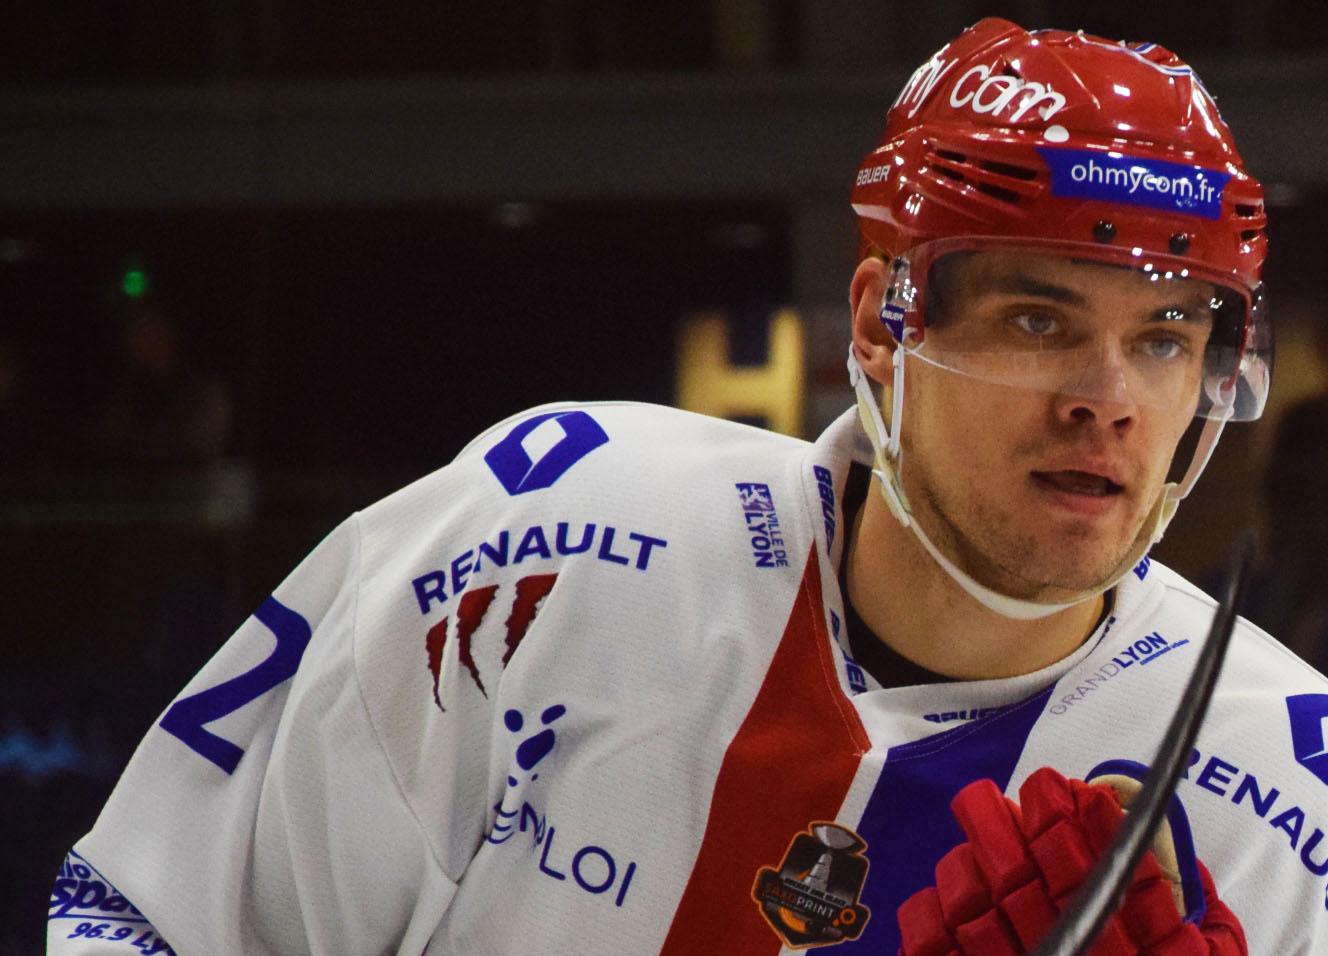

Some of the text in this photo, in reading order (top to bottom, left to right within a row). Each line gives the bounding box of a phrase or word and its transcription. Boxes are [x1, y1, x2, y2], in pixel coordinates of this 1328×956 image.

[1071, 160, 1215, 203] ohmycom.fr
[744, 512, 776, 568] LYON
[766, 512, 791, 568] VILLE DE
[411, 522, 667, 615] RENAULT
[67, 922, 134, 941] 96.9
